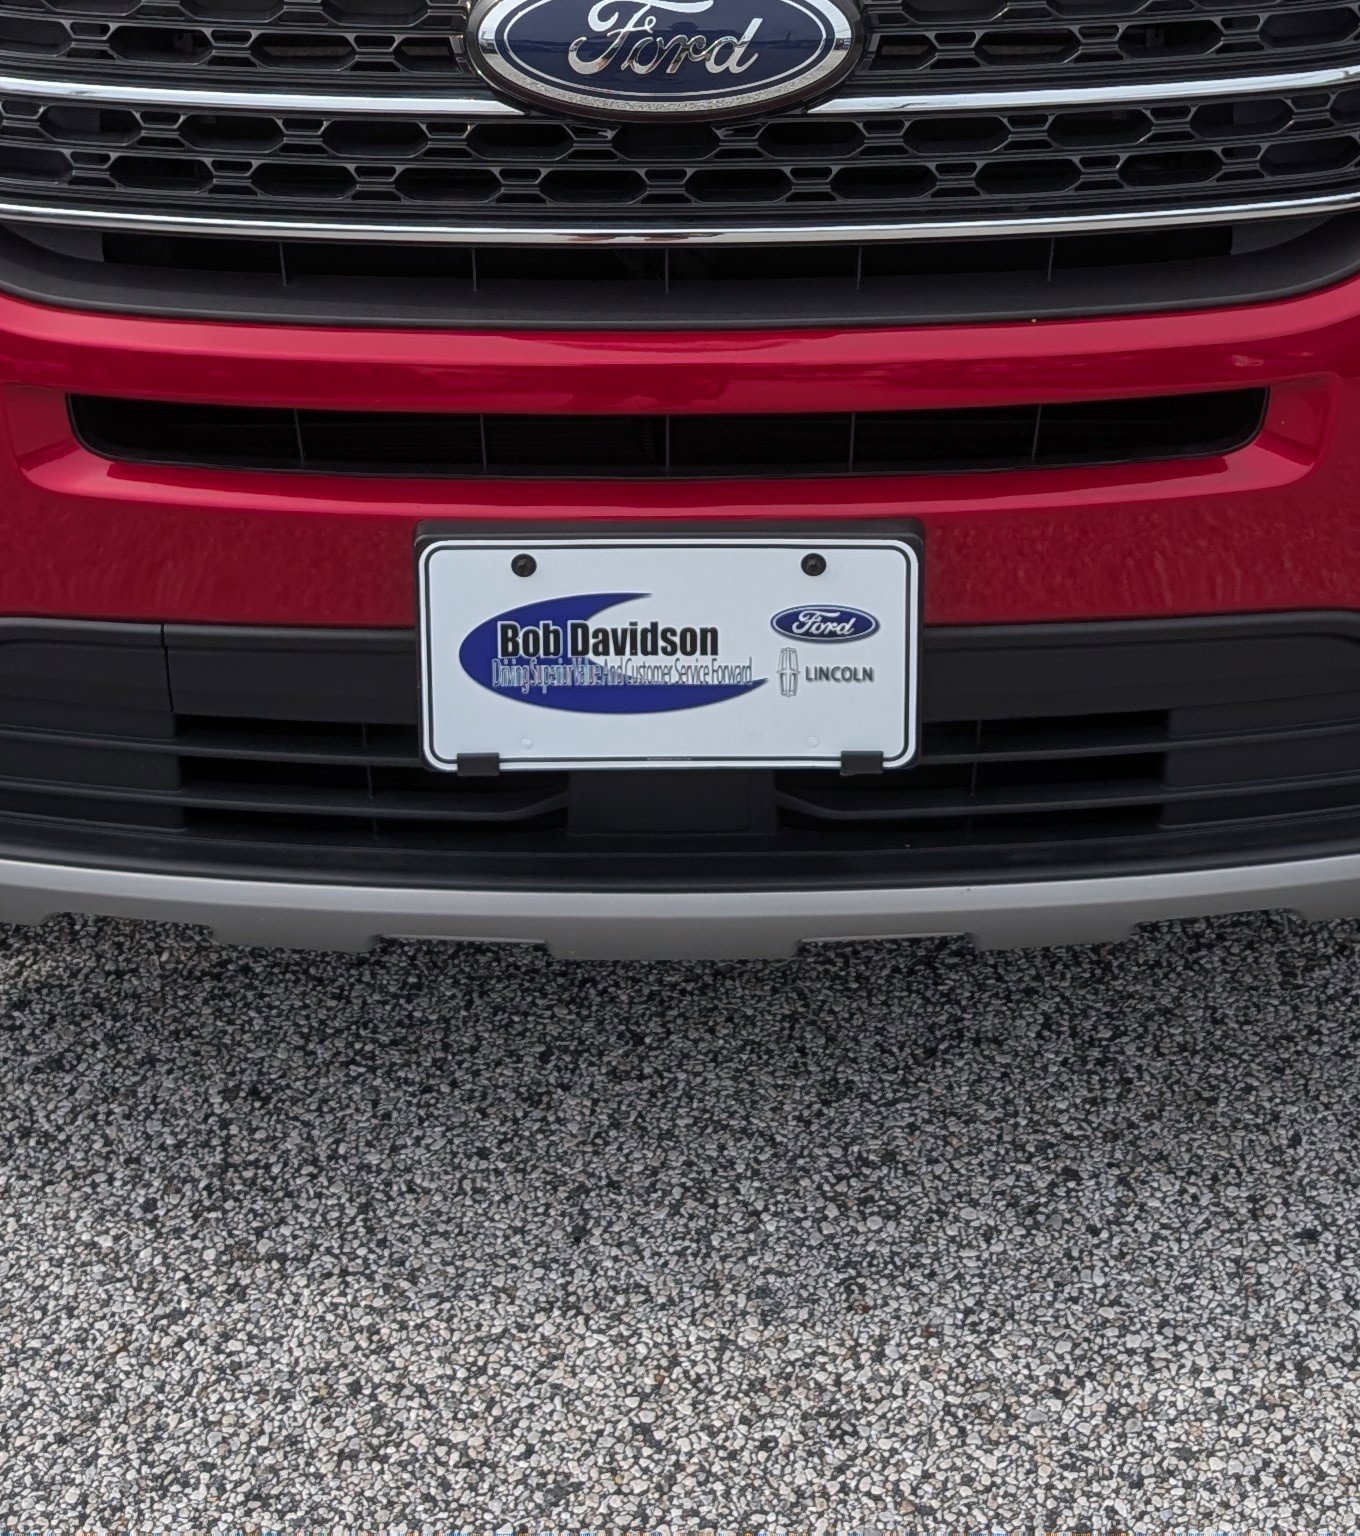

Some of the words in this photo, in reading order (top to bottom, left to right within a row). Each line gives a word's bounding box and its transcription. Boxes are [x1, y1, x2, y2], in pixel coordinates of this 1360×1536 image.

[792, 609, 857, 635] Ford
[499, 621, 562, 658] Bob
[570, 620, 719, 658] Davidson
[492, 658, 529, 694] Driving
[529, 657, 572, 694] Superior
[602, 657, 624, 685] And
[625, 657, 673, 685] Customer
[674, 657, 710, 685] Service
[711, 656, 753, 685] Forward
[805, 665, 875, 683] LINCOLN
